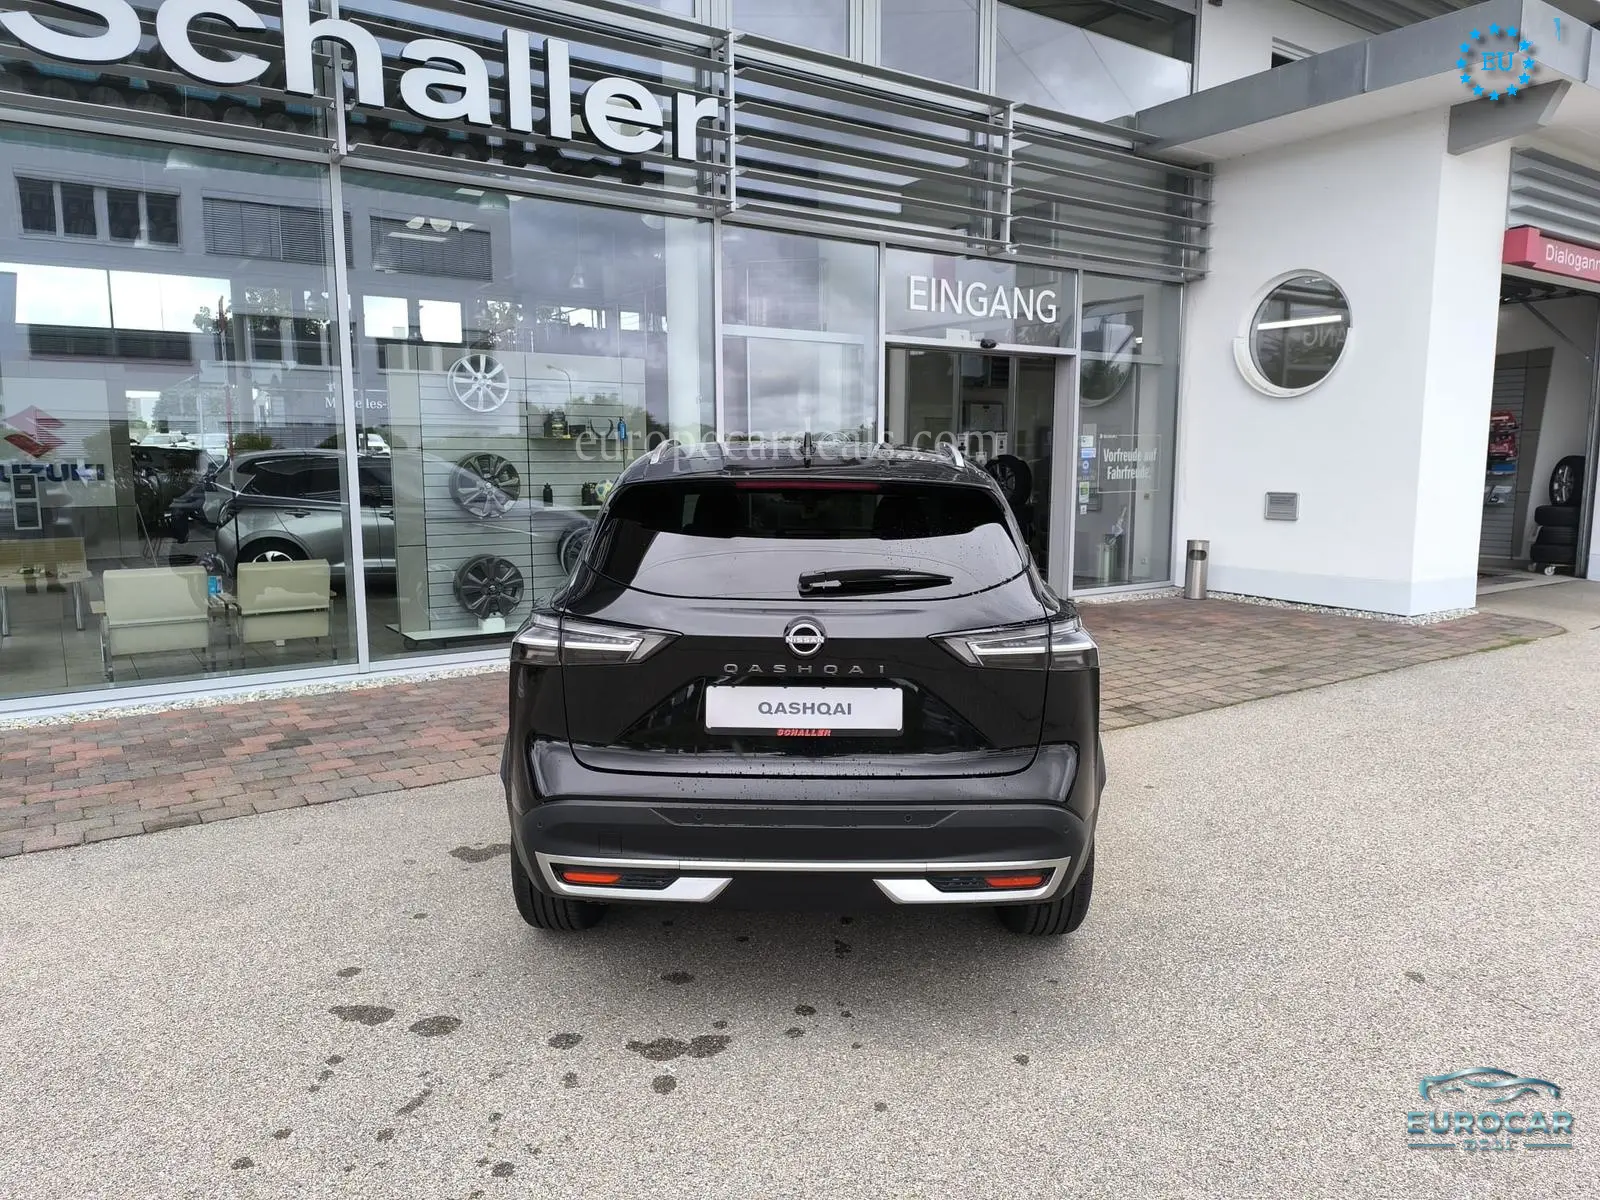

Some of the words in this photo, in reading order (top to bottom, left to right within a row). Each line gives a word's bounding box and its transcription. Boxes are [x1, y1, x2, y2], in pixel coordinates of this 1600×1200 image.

[909, 275, 1057, 323] EINGANG
[1103, 448, 1142, 462] Vorfreude
[723, 663, 885, 675] QASHQAI
[758, 702, 852, 716] QASHQAI
[776, 728, 832, 737] SCHALLER
